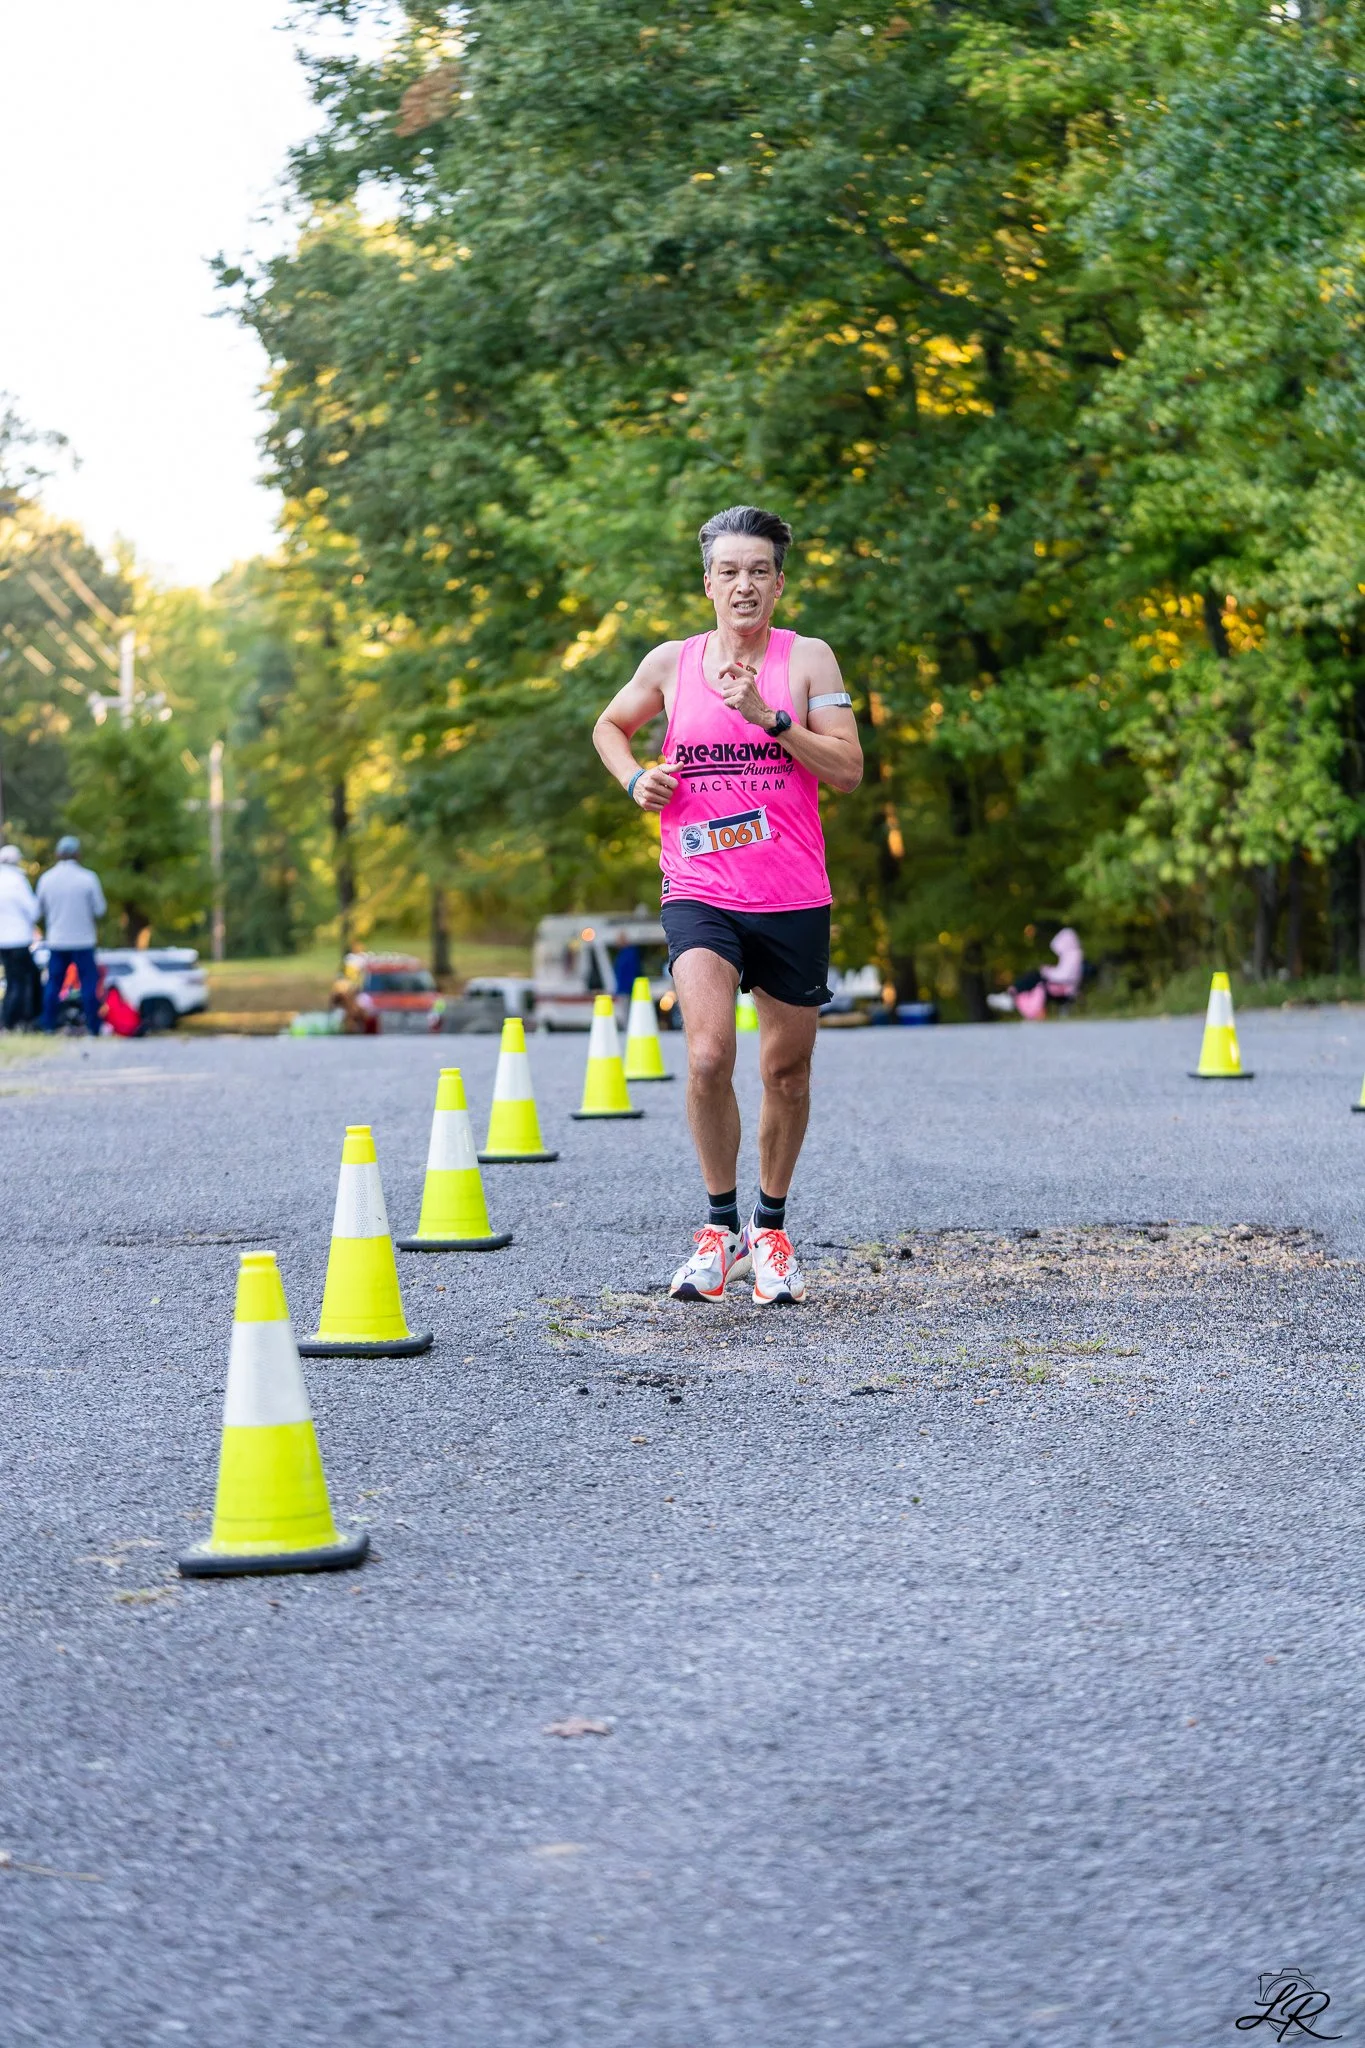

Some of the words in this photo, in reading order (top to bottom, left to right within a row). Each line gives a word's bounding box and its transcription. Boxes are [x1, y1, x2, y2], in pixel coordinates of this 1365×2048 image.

[744, 762, 795, 776] Running
[690, 780, 732, 793] RACE
[741, 779, 786, 791] TEAM
[707, 820, 764, 851] 1061
